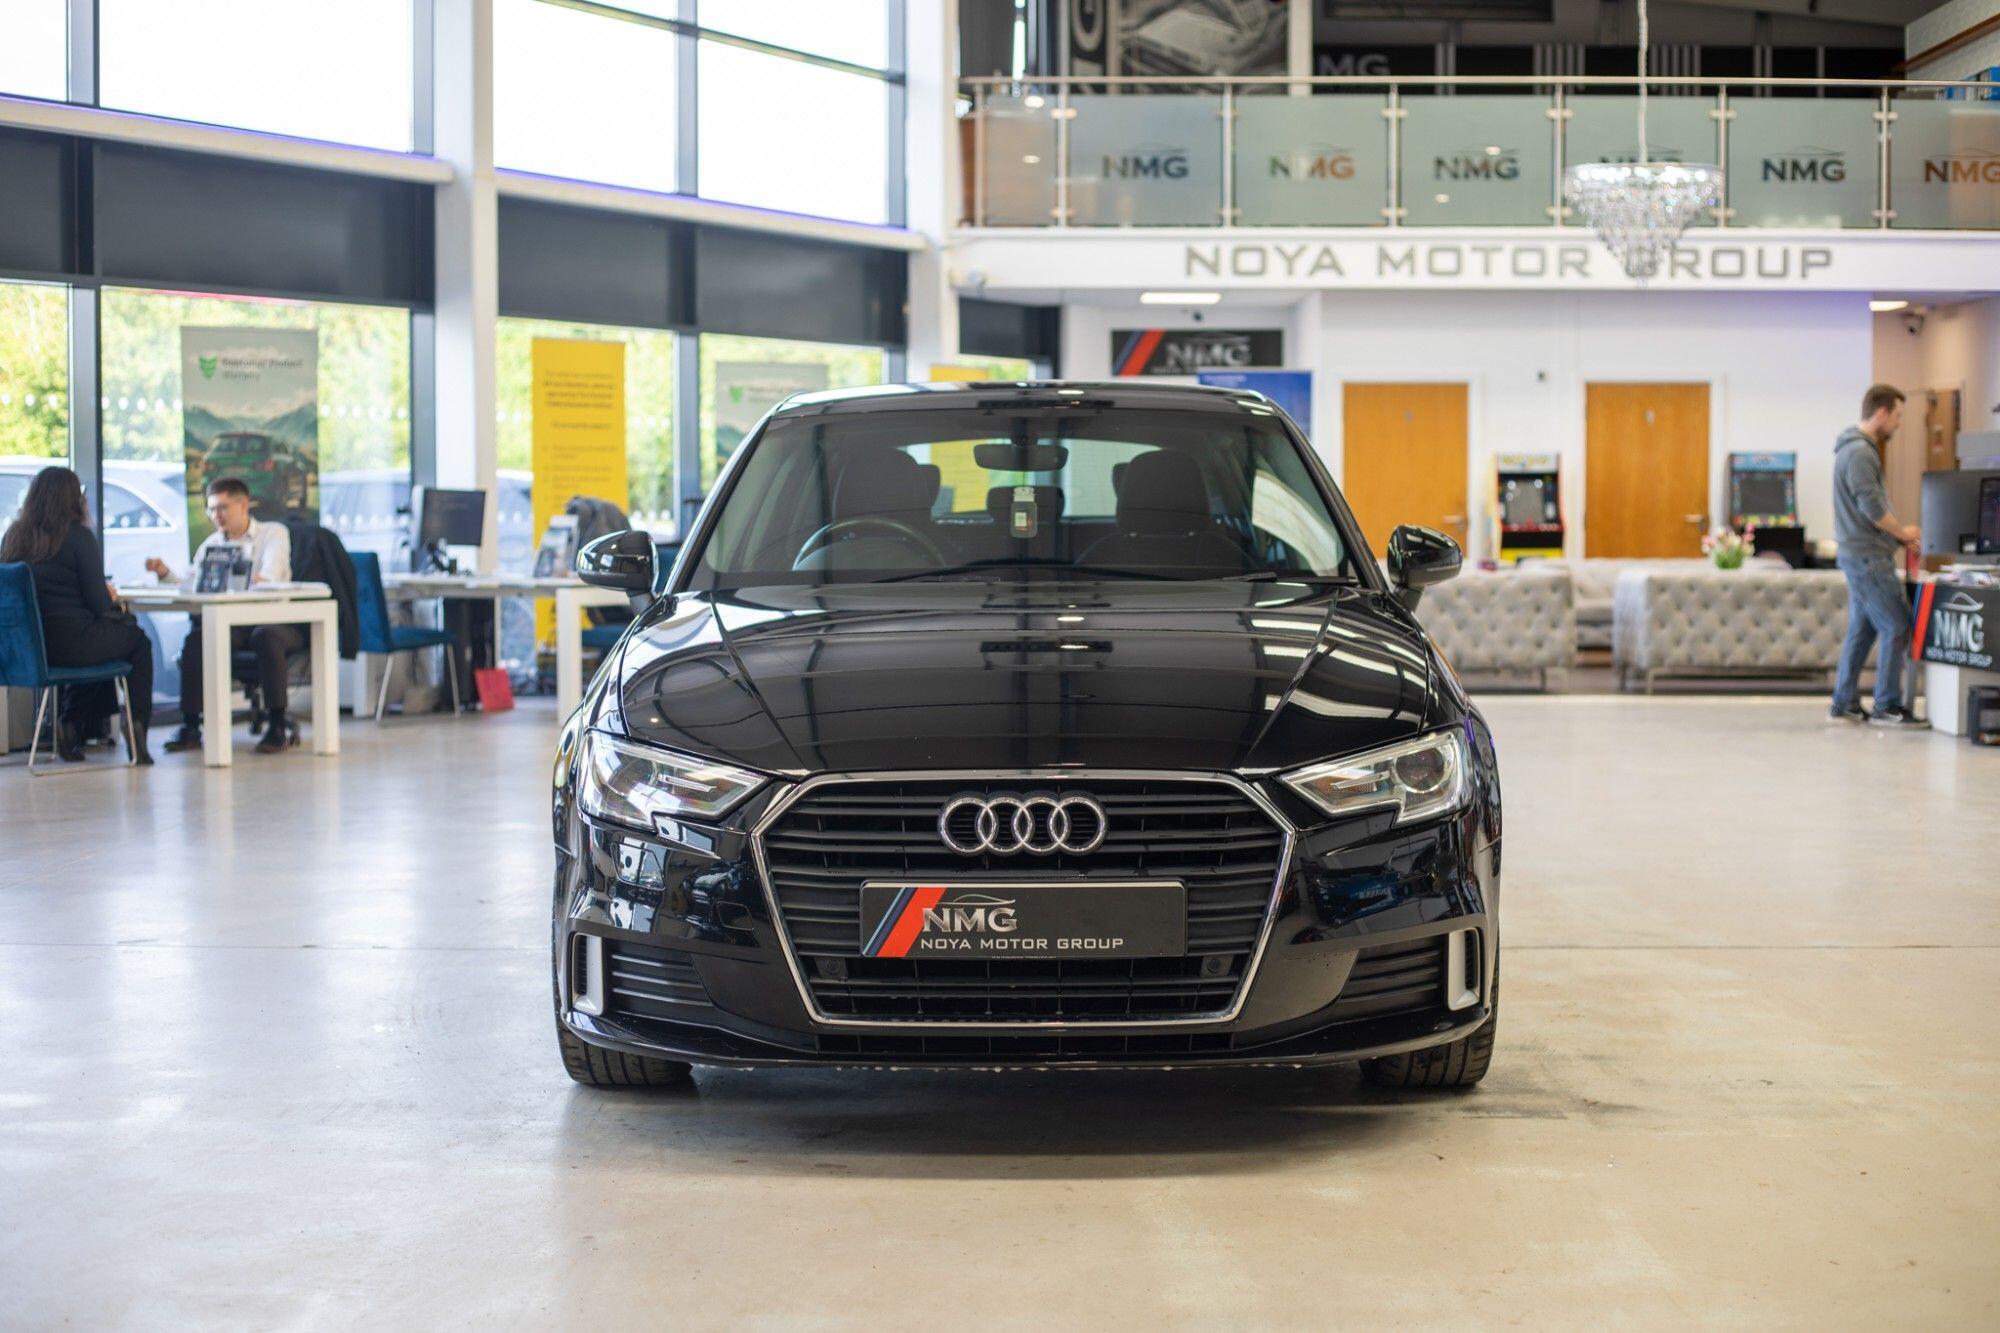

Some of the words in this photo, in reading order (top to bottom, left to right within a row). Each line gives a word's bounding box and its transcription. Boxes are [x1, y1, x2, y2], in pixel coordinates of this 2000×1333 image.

[1103, 155, 1189, 179] NMG
[1434, 156, 1519, 180] NMG
[1762, 159, 1846, 182] NMG
[1186, 246, 1344, 276] NOYA
[1378, 247, 1591, 278] MOTOR
[1166, 342, 1251, 369] NMG
[1934, 609, 1985, 653] NMG
[922, 907, 1018, 932] NMG
[920, 938, 972, 949] NOYA
[980, 938, 1048, 949] MOTOR
[1056, 938, 1124, 949] GROUP
